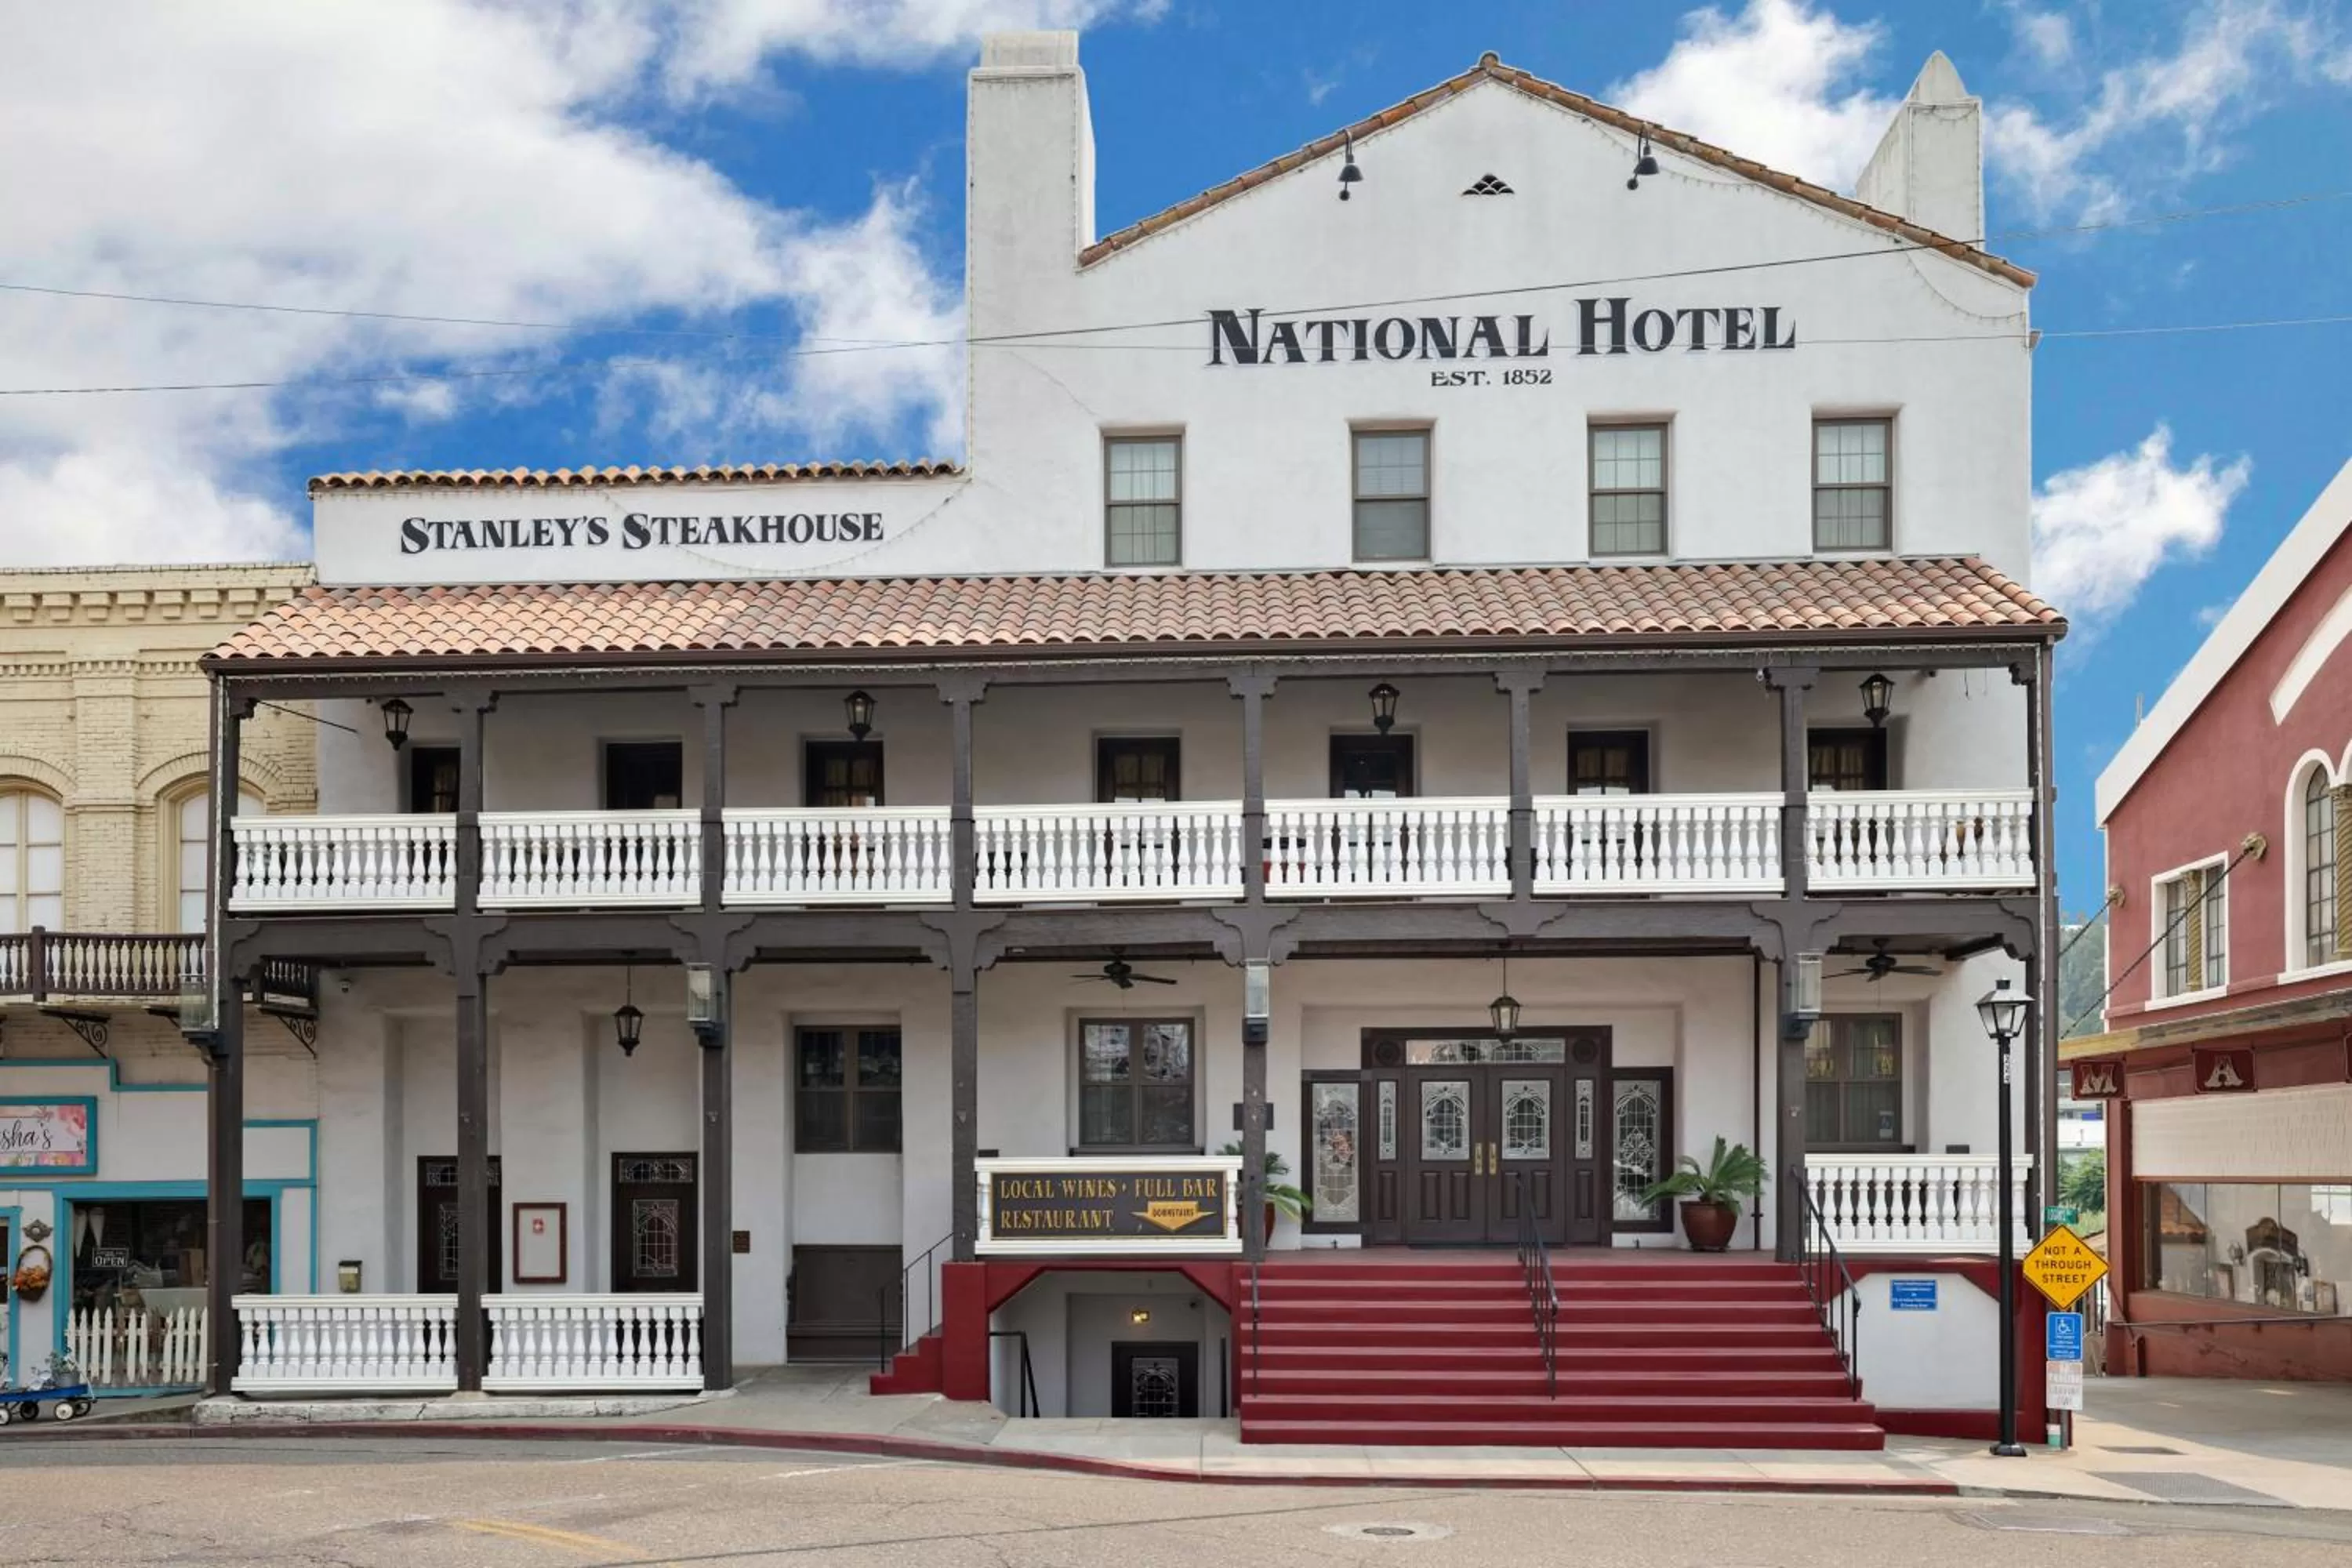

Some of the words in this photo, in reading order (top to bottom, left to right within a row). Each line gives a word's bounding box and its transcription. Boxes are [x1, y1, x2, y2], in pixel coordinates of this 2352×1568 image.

[1207, 308, 1549, 365] NATIONAL
[1576, 297, 1795, 355] HOTEL
[1431, 371, 1491, 387] EST.
[1504, 369, 1552, 386] 1852
[401, 516, 609, 554] STANLEY'S
[623, 514, 884, 550] STEAKHOUSE
[2079, 1063, 2118, 1094] M
[2204, 1054, 2245, 1088] A
[1000, 1179, 1054, 1199] LOCAL
[1063, 1178, 1116, 1198] WINES
[1134, 1178, 1176, 1198] FULL
[1182, 1178, 1218, 1198] BAR
[1000, 1210, 1114, 1229] RESTAURANT
[2044, 1246, 2067, 1255] NOT
[2074, 1247, 2082, 1255] A
[95, 1255, 125, 1267] OPEN
[2034, 1260, 2092, 1269] THROUGH
[2042, 1274, 2087, 1283] STREET
